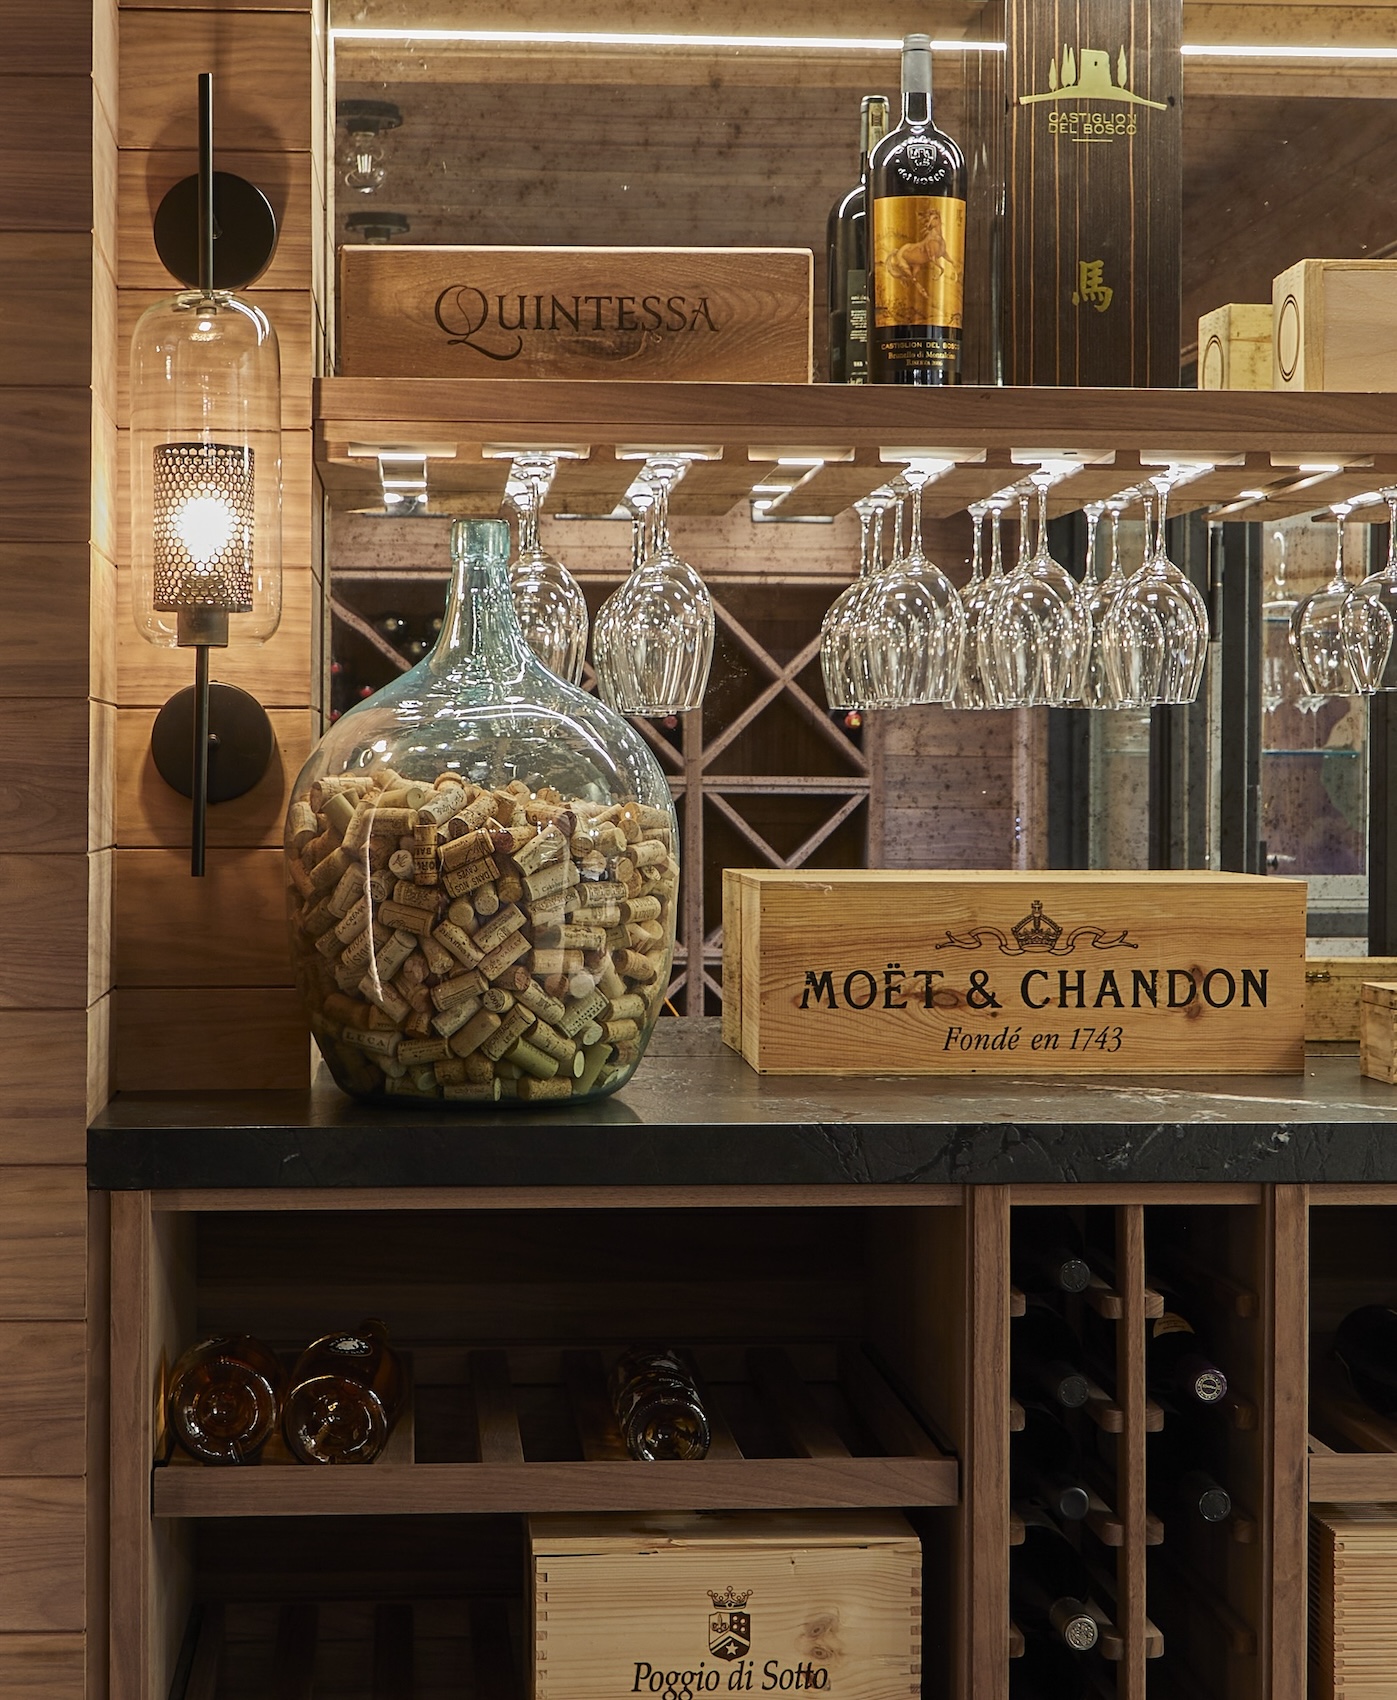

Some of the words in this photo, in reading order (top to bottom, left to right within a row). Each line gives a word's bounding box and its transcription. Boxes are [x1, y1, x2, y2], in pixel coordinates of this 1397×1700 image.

[1048, 112, 1137, 124] CASTIGLION
[1048, 123, 1077, 134] DEL
[1083, 124, 1137, 135] BOSCO
[1072, 260, 1113, 312] 馬
[434, 284, 720, 361] QUINTESSA
[457, 864, 478, 880] CAVES
[472, 871, 491, 887] DANS
[454, 880, 470, 893] NOS
[501, 939, 522, 958] VALLEY
[799, 963, 944, 1009] MOËT
[966, 969, 1002, 1010] &
[1020, 968, 1269, 1010] CHANDON
[345, 1031, 386, 1047] LUCA
[942, 1026, 1021, 1051] Fondé
[1031, 1032, 1060, 1051] en
[1069, 1026, 1125, 1053] 1743
[631, 1661, 721, 1700] Poggio
[728, 1660, 753, 1691] di
[761, 1660, 829, 1691] Sotto
